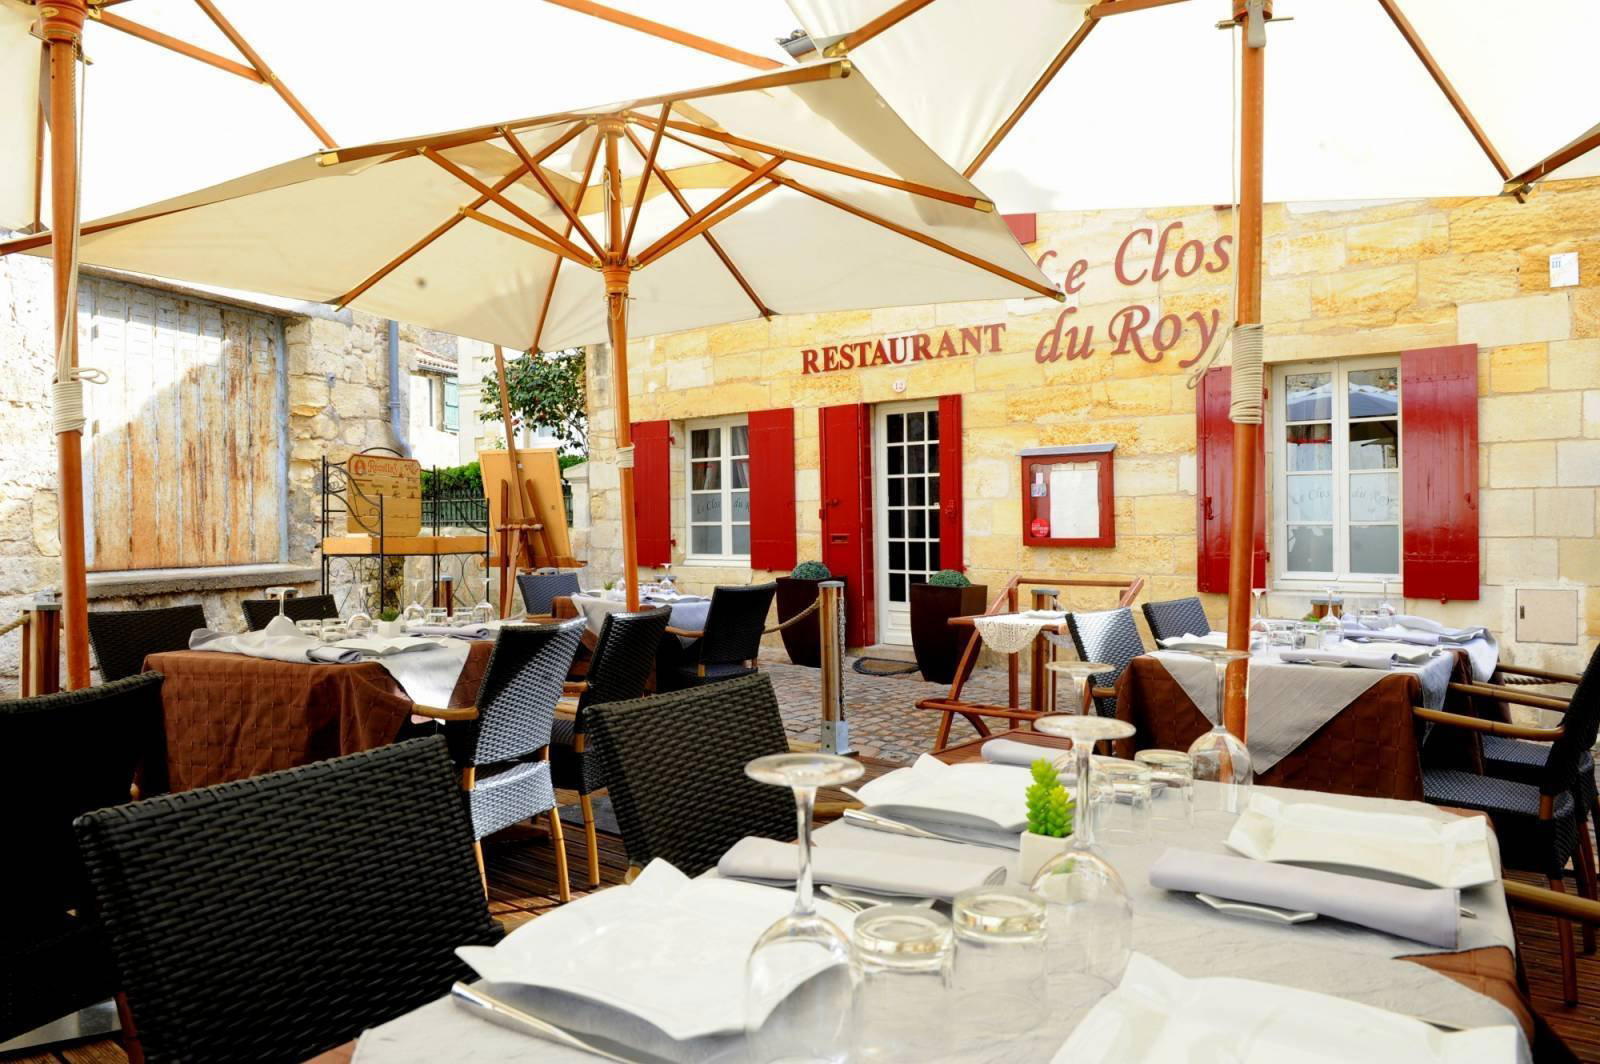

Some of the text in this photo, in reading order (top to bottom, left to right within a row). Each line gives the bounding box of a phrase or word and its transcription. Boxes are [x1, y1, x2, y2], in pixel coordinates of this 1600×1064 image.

[1114, 221, 1233, 286] Clos
[800, 322, 1006, 375] RESTAURANT
[1035, 304, 1220, 368] du Roy
